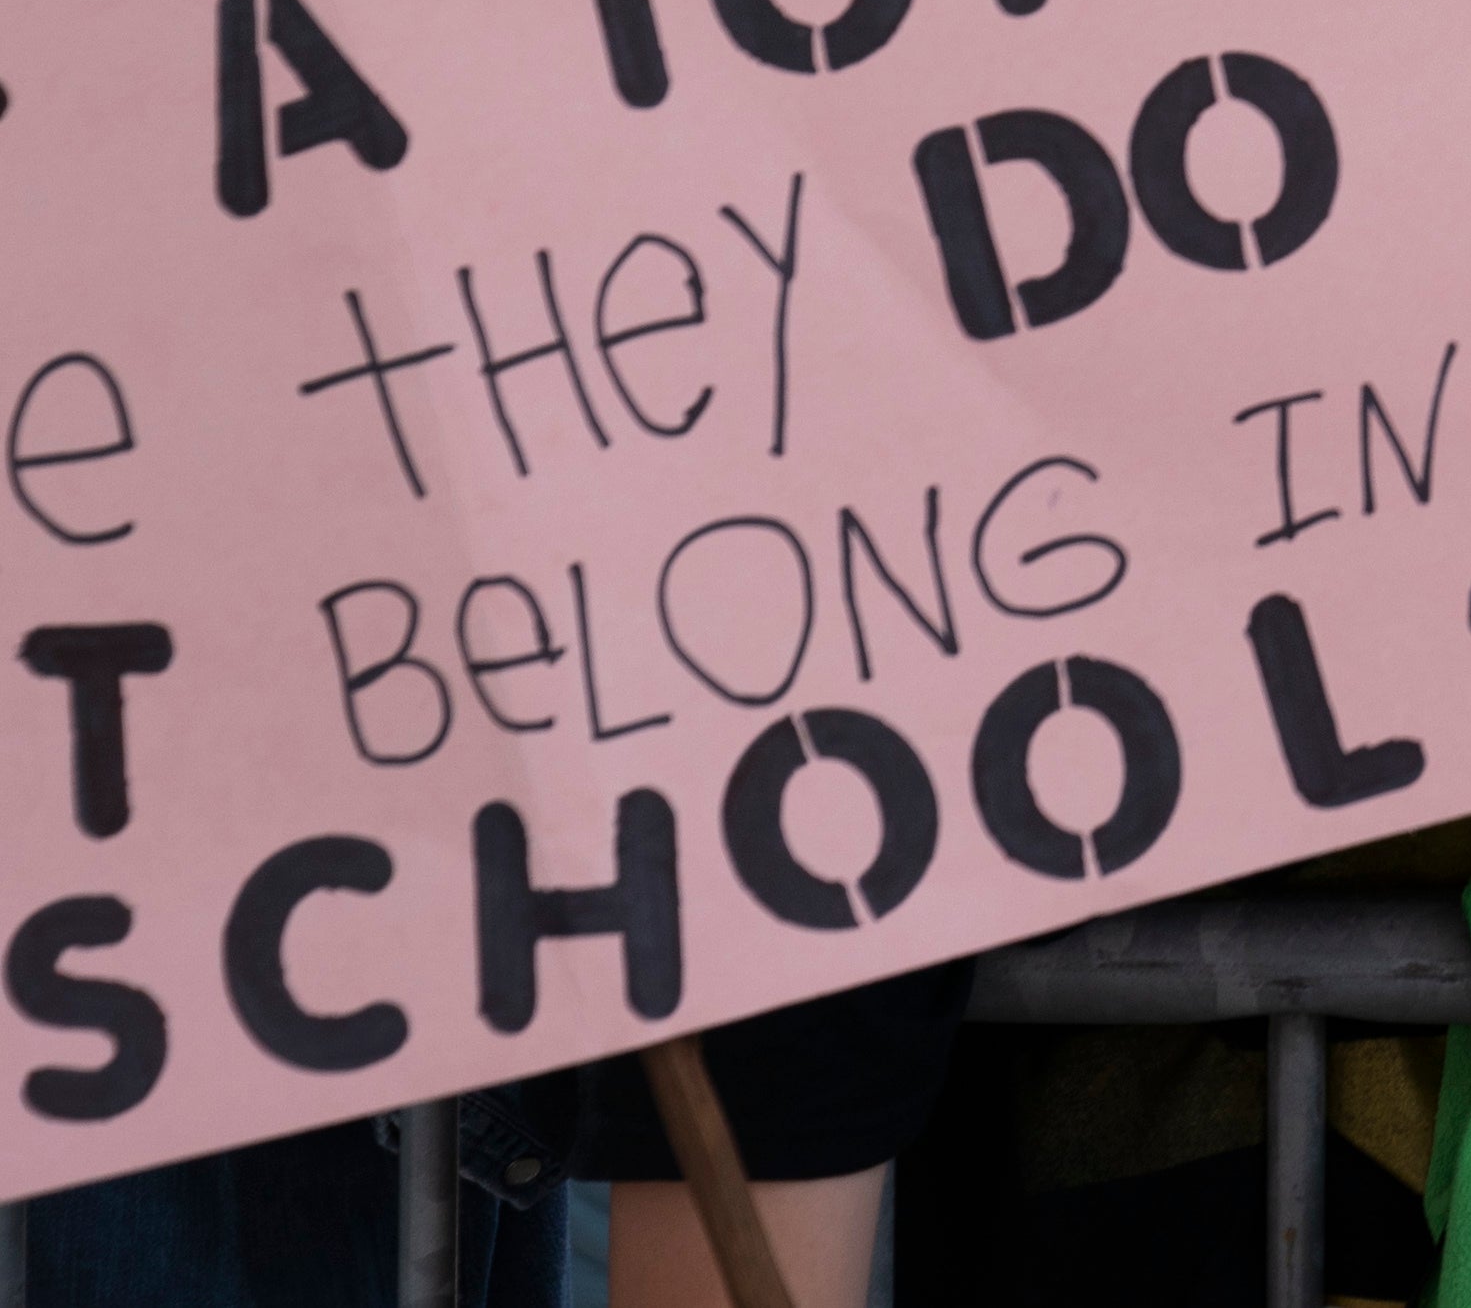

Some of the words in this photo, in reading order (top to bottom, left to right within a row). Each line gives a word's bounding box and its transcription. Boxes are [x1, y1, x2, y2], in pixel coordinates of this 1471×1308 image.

[9, 352, 135, 544] e
[913, 52, 1340, 341] DO
[19, 622, 174, 839] T
[1235, 342, 1459, 547] IN
